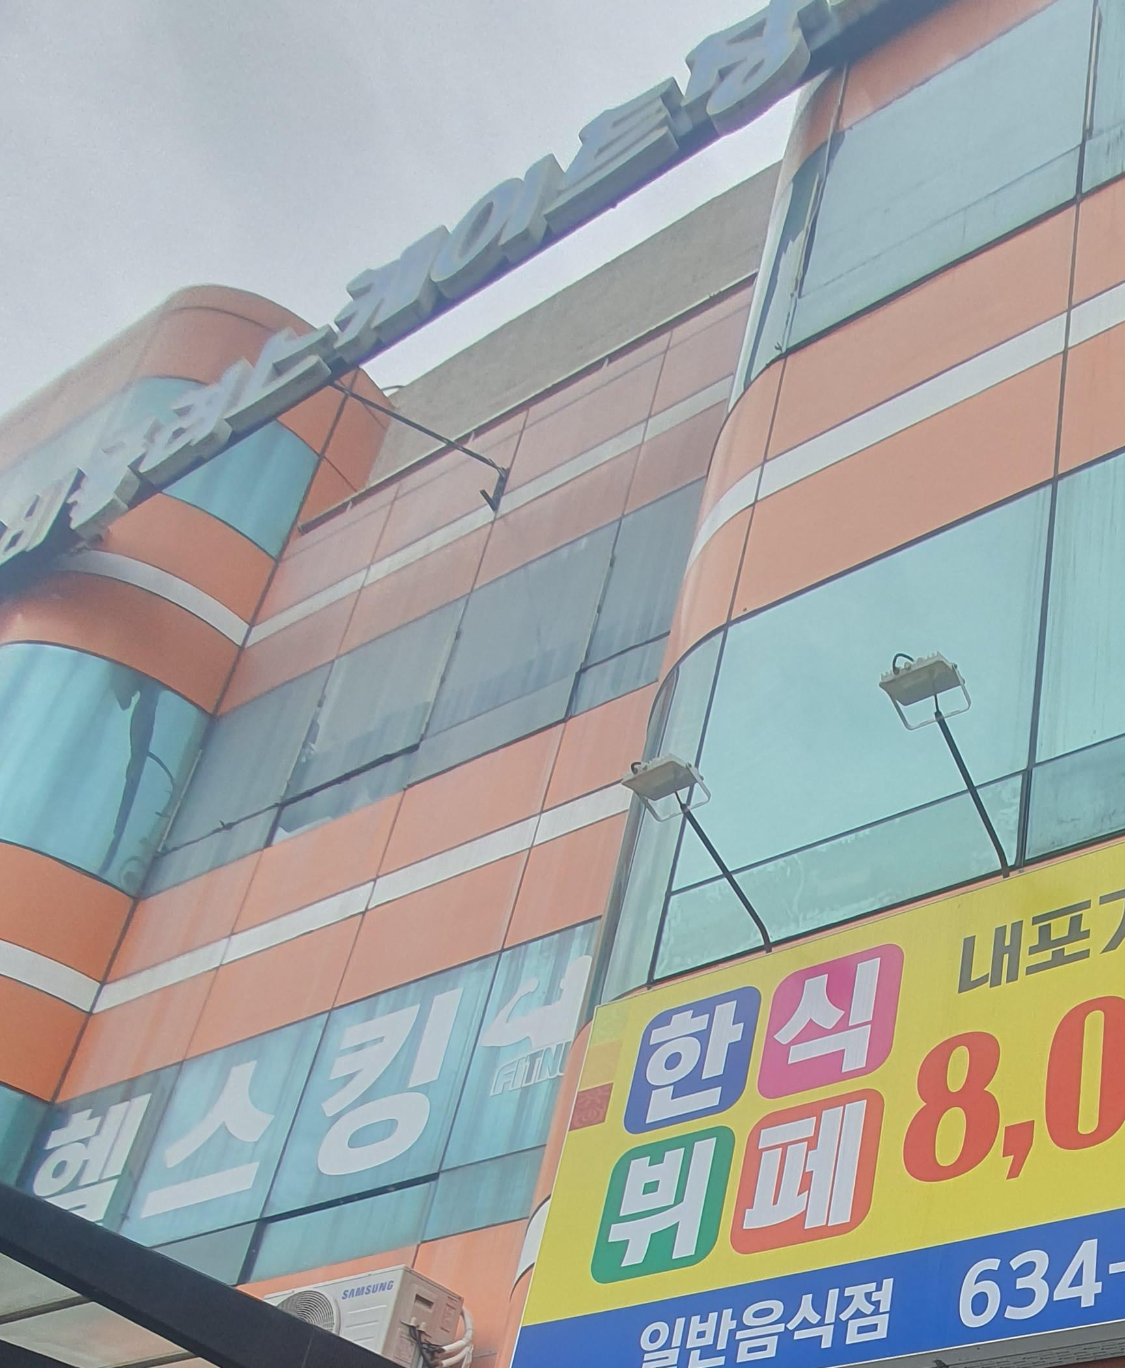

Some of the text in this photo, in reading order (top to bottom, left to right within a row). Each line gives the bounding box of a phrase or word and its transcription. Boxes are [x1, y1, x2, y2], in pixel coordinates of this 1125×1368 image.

[645, 956, 882, 1125] 한식
[607, 1098, 868, 1268] 뷔페
[341, 1280, 395, 1300] SAMSUNG
